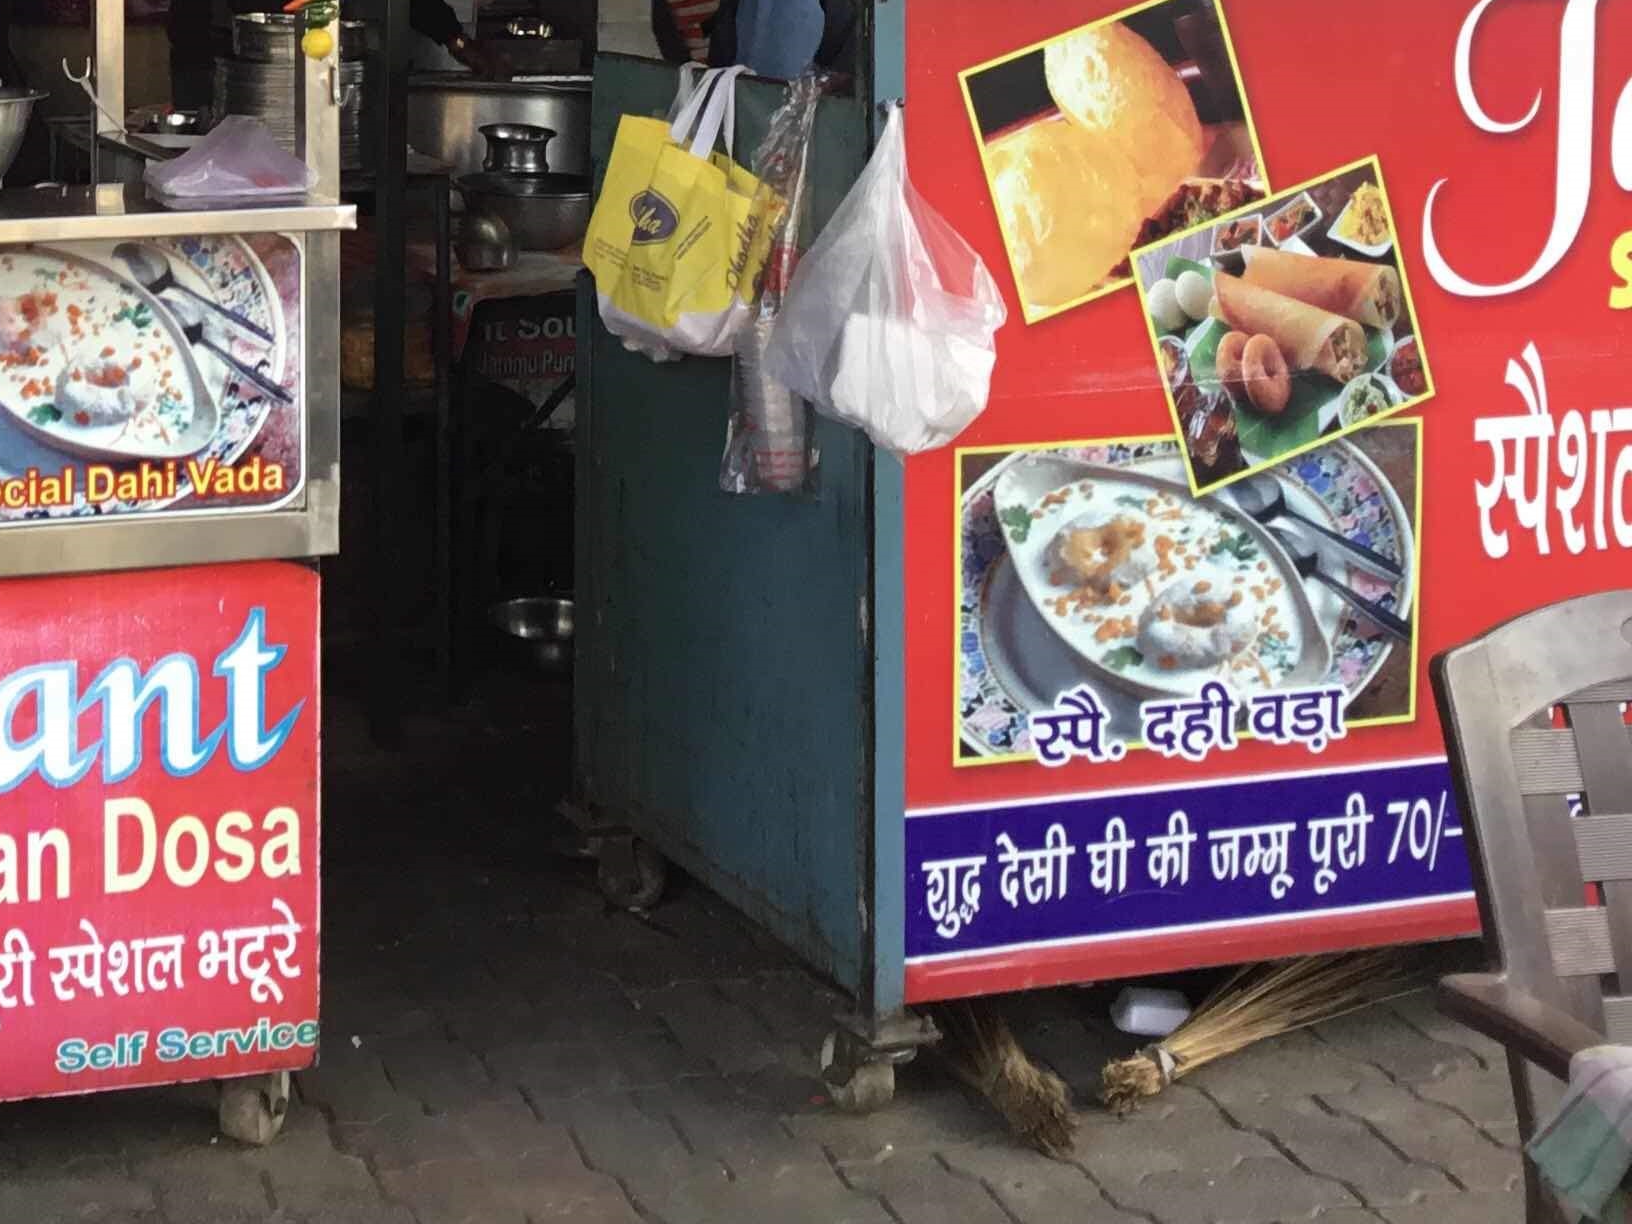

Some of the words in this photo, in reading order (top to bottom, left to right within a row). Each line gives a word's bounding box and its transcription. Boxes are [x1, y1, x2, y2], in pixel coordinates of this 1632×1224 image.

[516, 312, 576, 339] SOU
[85, 464, 177, 507] Dahi
[187, 458, 284, 498] Vada
[1142, 681, 1238, 757] दही
[103, 793, 302, 893] Dosa
[996, 823, 1075, 909] देसी
[1087, 816, 1135, 895] घी
[1146, 810, 1197, 888] की
[1208, 822, 1296, 900] जम्मू
[1308, 792, 1373, 895] पूरी
[1386, 789, 1464, 872] 70/-
[50, 919, 185, 1006] स्पेशल
[199, 898, 303, 1003] भटूरे
[54, 1029, 148, 1074] Self
[157, 1018, 319, 1062] Service
